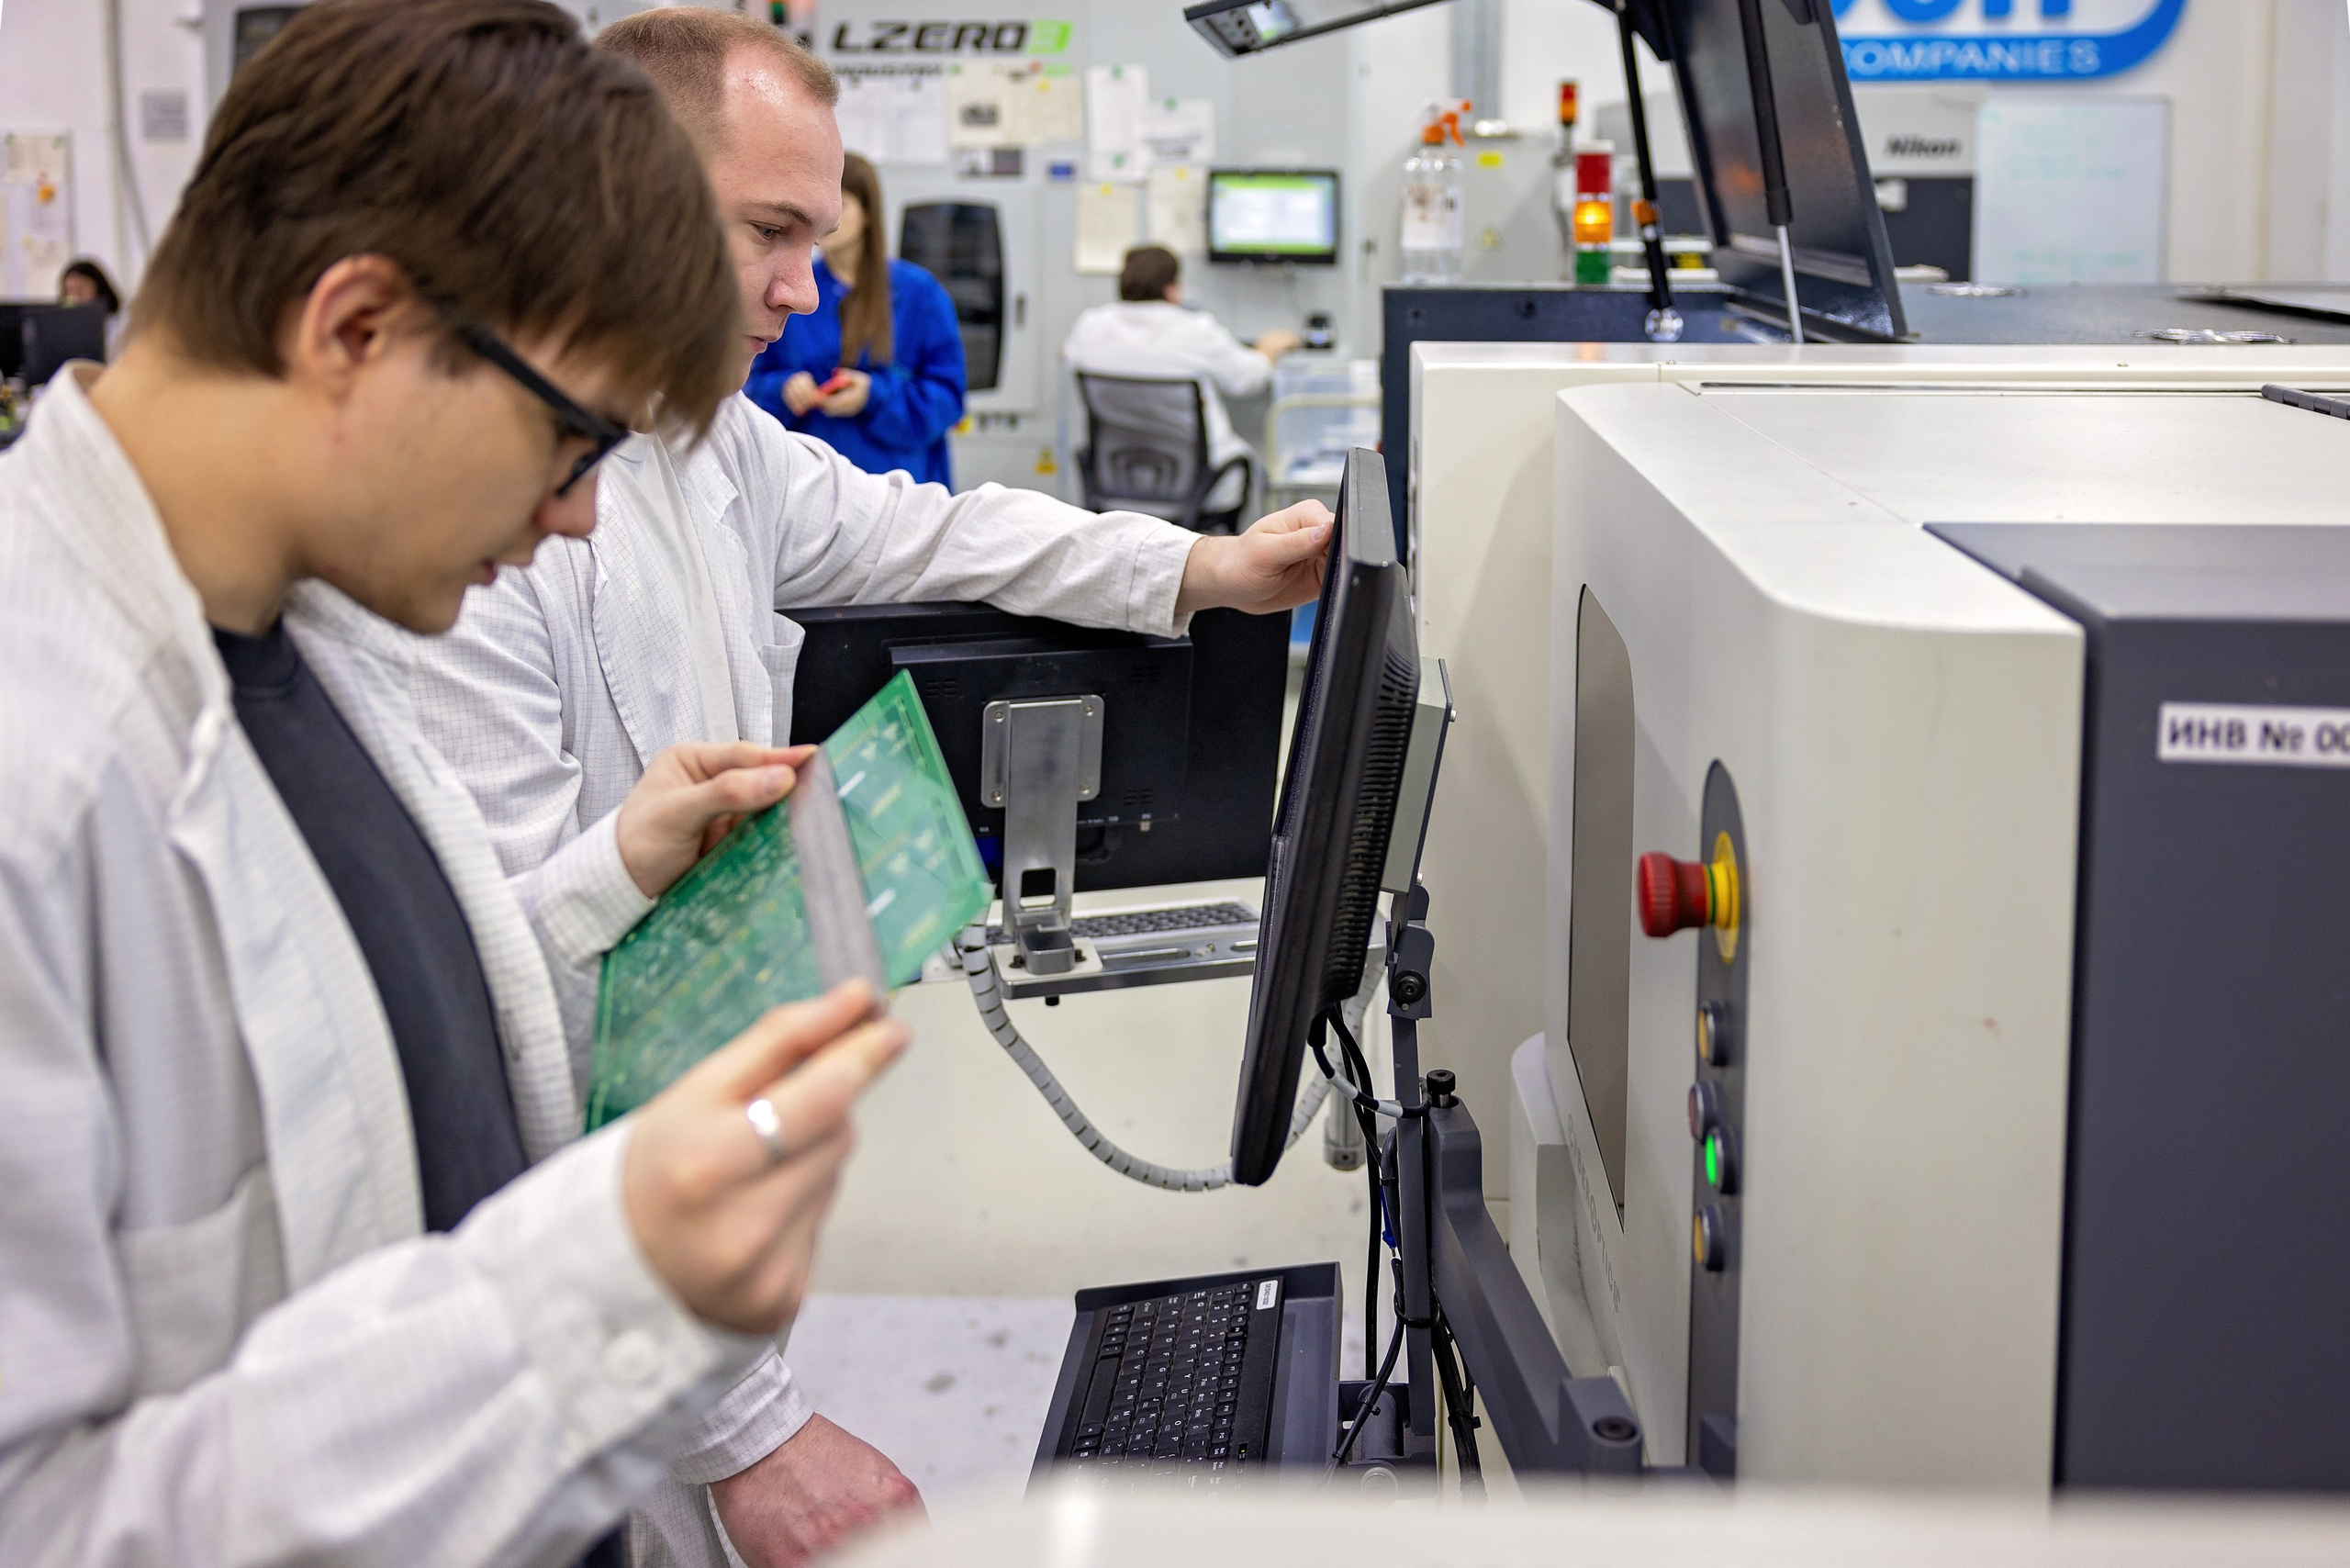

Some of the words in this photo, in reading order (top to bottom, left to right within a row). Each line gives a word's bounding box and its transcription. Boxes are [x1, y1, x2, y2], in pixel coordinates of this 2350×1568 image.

[1840, 39, 2102, 75] OMPANIES
[2169, 716, 2245, 749] ИНВ
[2259, 720, 2305, 754] №
